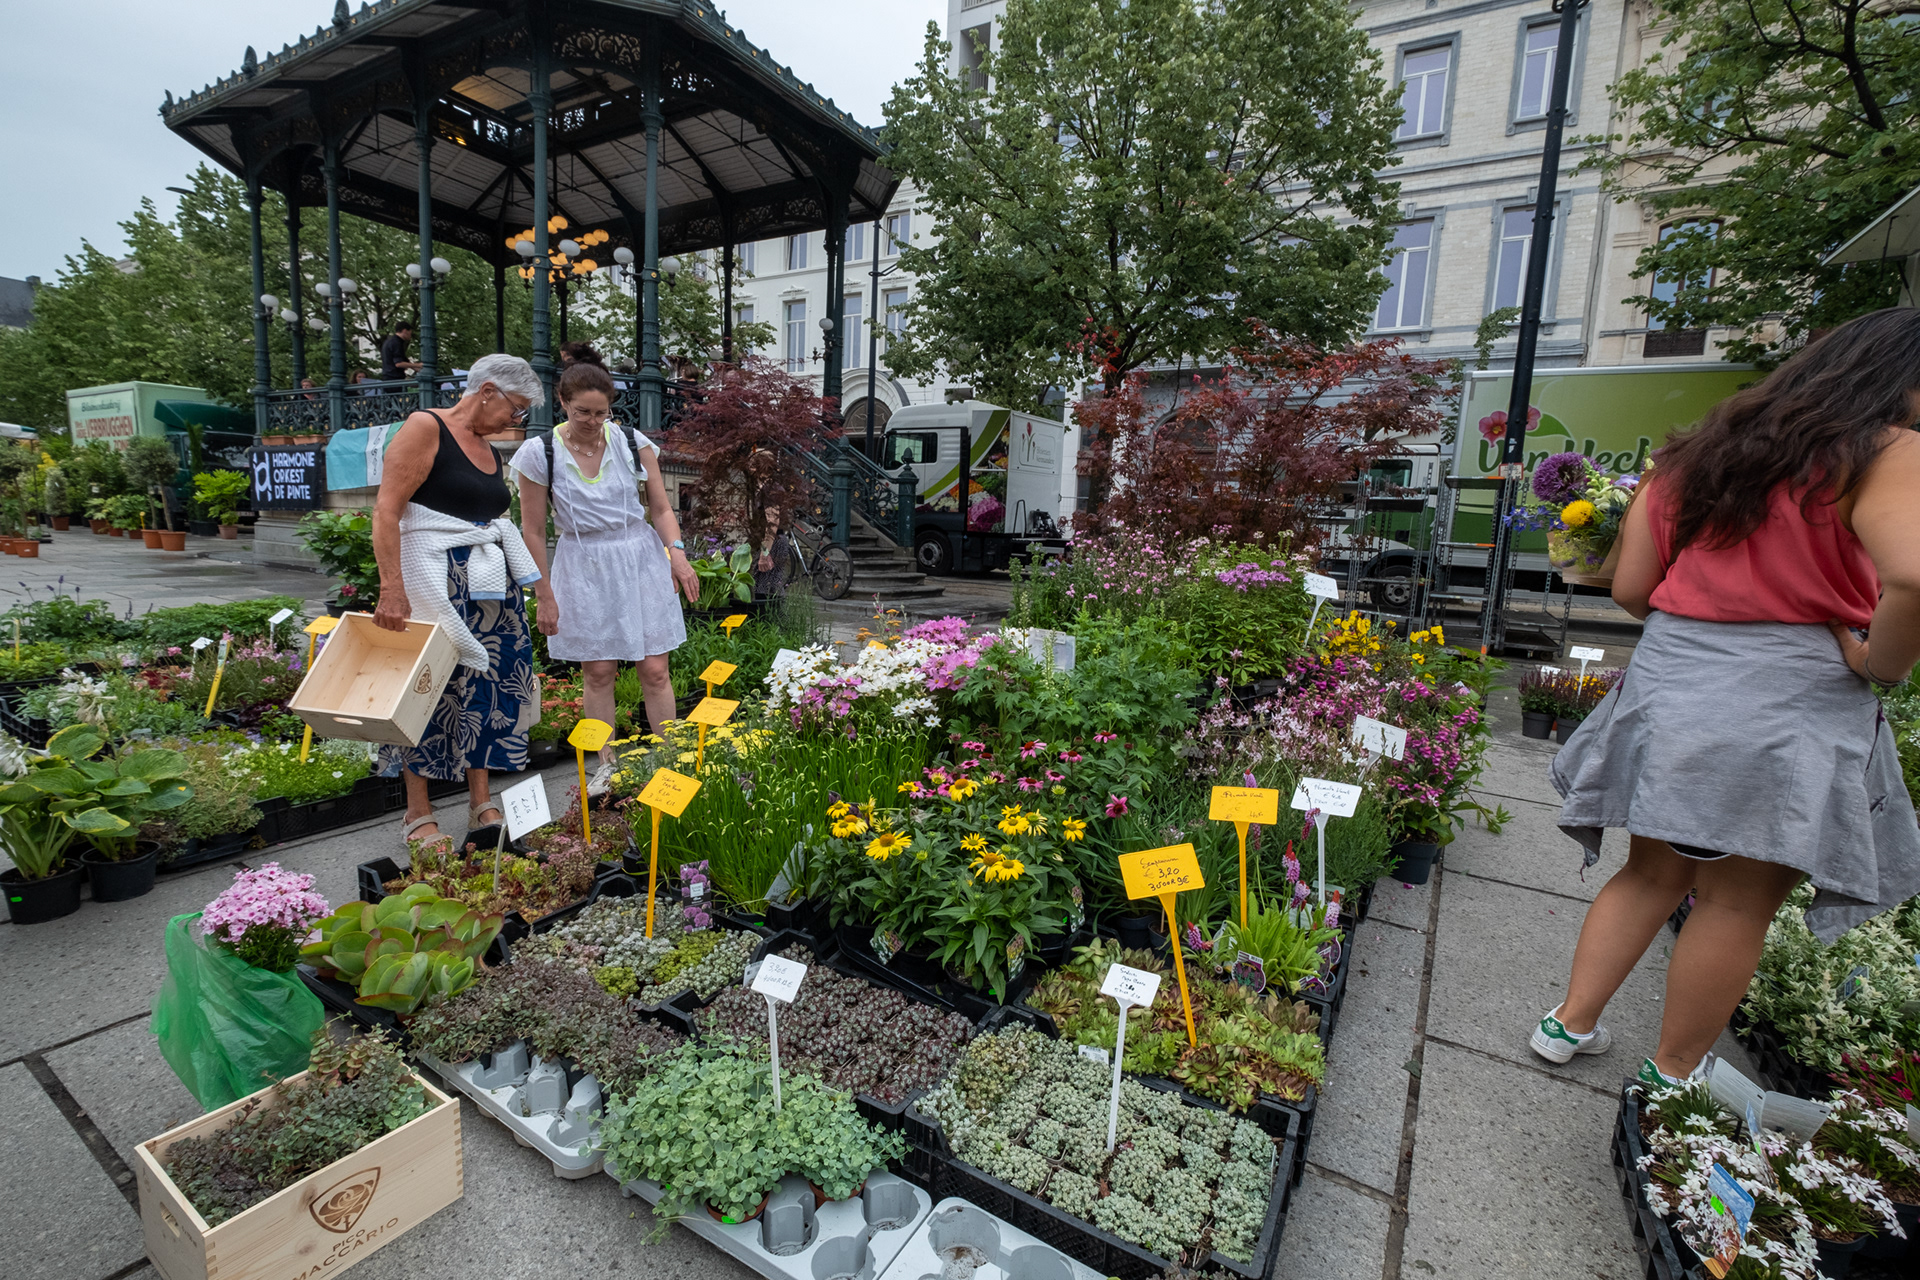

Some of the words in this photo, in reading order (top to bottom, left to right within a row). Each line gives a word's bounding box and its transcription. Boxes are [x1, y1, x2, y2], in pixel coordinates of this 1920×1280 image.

[272, 452, 315, 467] HARMONIE
[273, 468, 305, 483] ORKEST
[274, 485, 285, 499] DE
[287, 485, 311, 500] PINTE
[1158, 867, 1180, 879] 3,20
[332, 1229, 366, 1252] PICO
